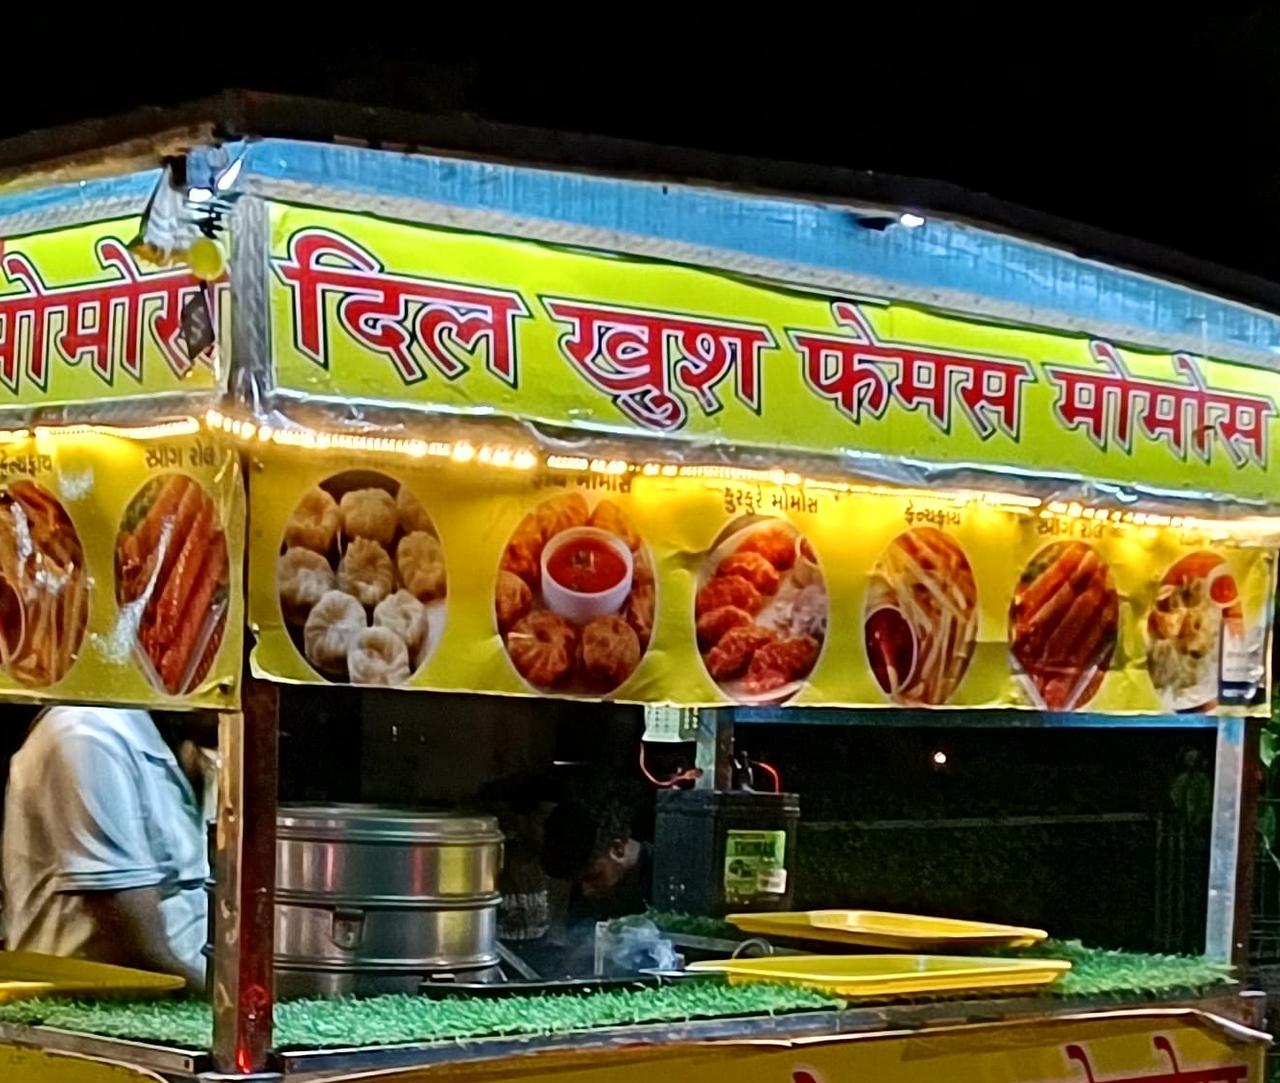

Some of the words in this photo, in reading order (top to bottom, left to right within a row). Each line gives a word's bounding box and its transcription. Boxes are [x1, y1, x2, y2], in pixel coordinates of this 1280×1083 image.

[270, 226, 531, 386] दिल
[538, 295, 780, 431] खुश
[786, 300, 1036, 442] फेमस
[1041, 337, 1278, 469] मोमोस
[771, 486, 819, 514] મોમોસ
